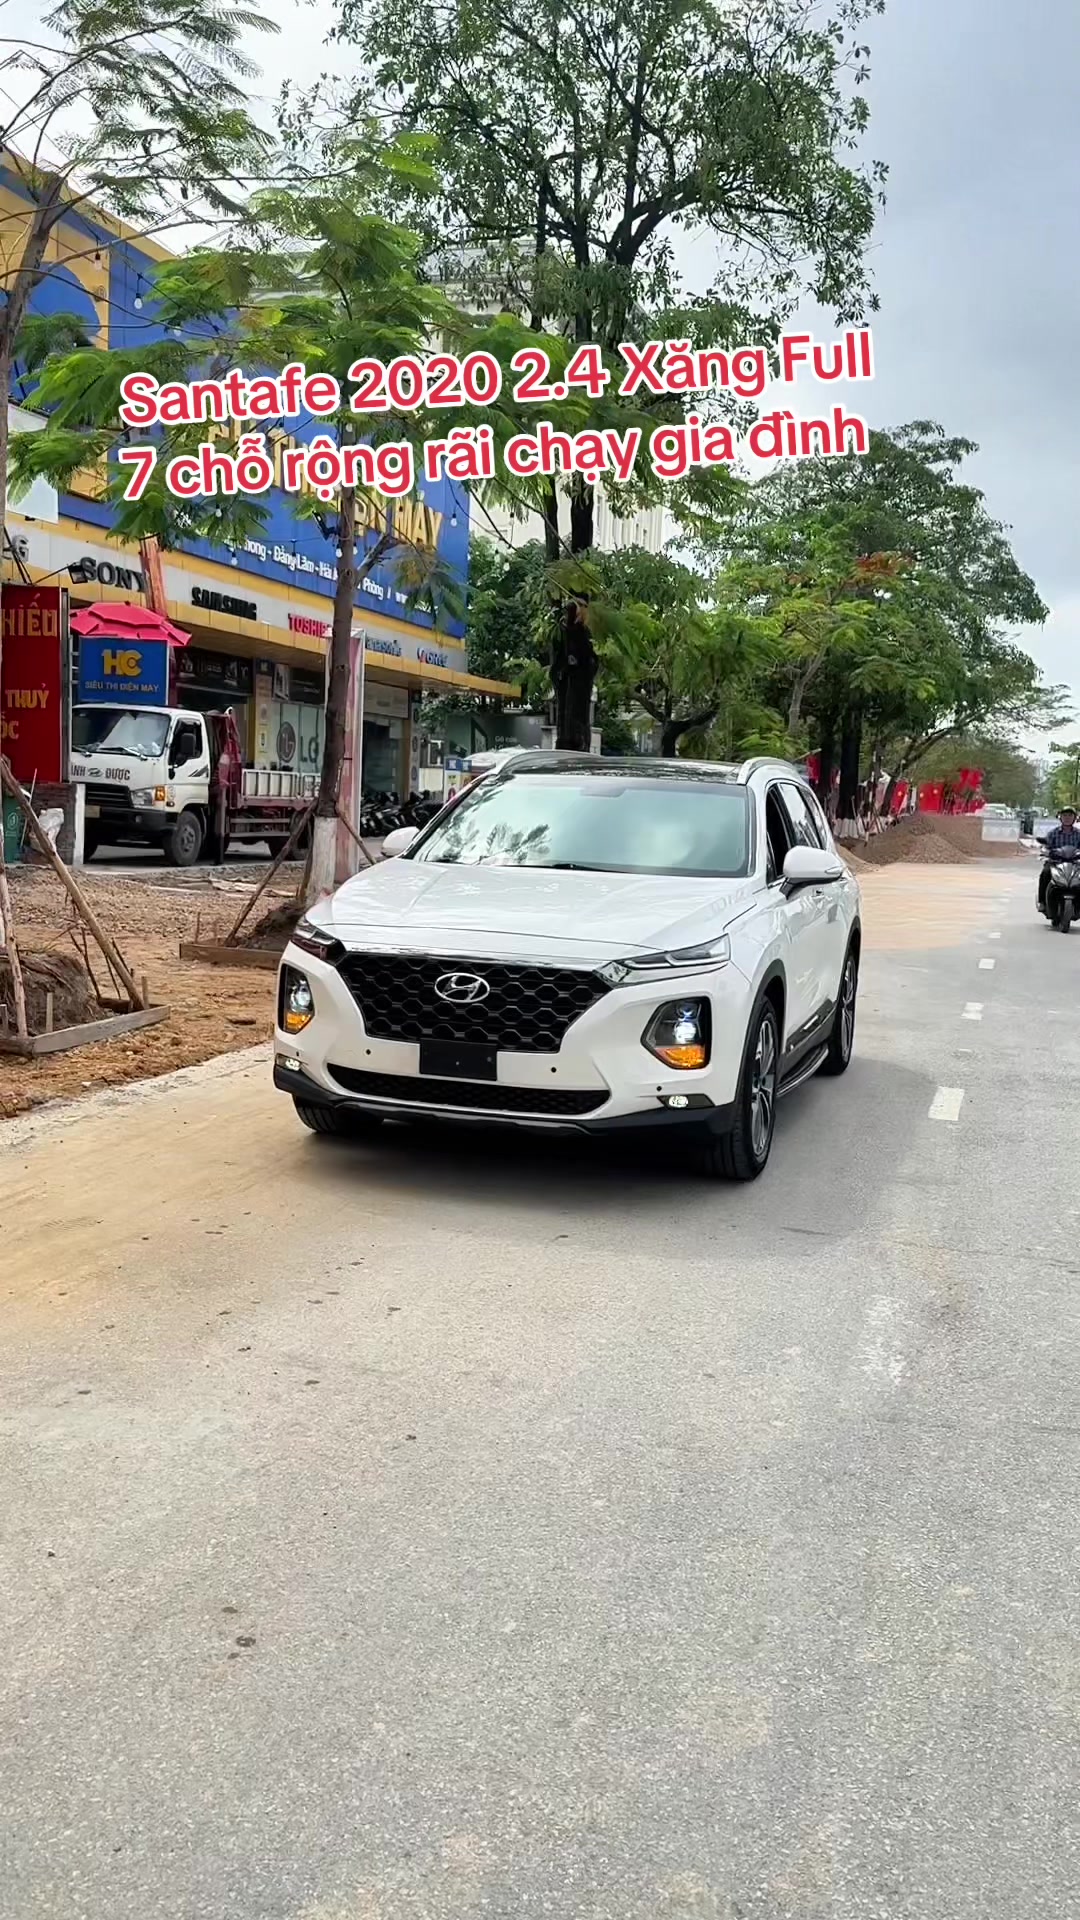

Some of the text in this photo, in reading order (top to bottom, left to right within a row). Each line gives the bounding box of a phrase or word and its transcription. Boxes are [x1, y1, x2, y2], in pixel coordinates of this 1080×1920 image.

[81, 556, 146, 593] SONY
[191, 587, 258, 621] SAMSUNG
[102, 649, 142, 677] HC
